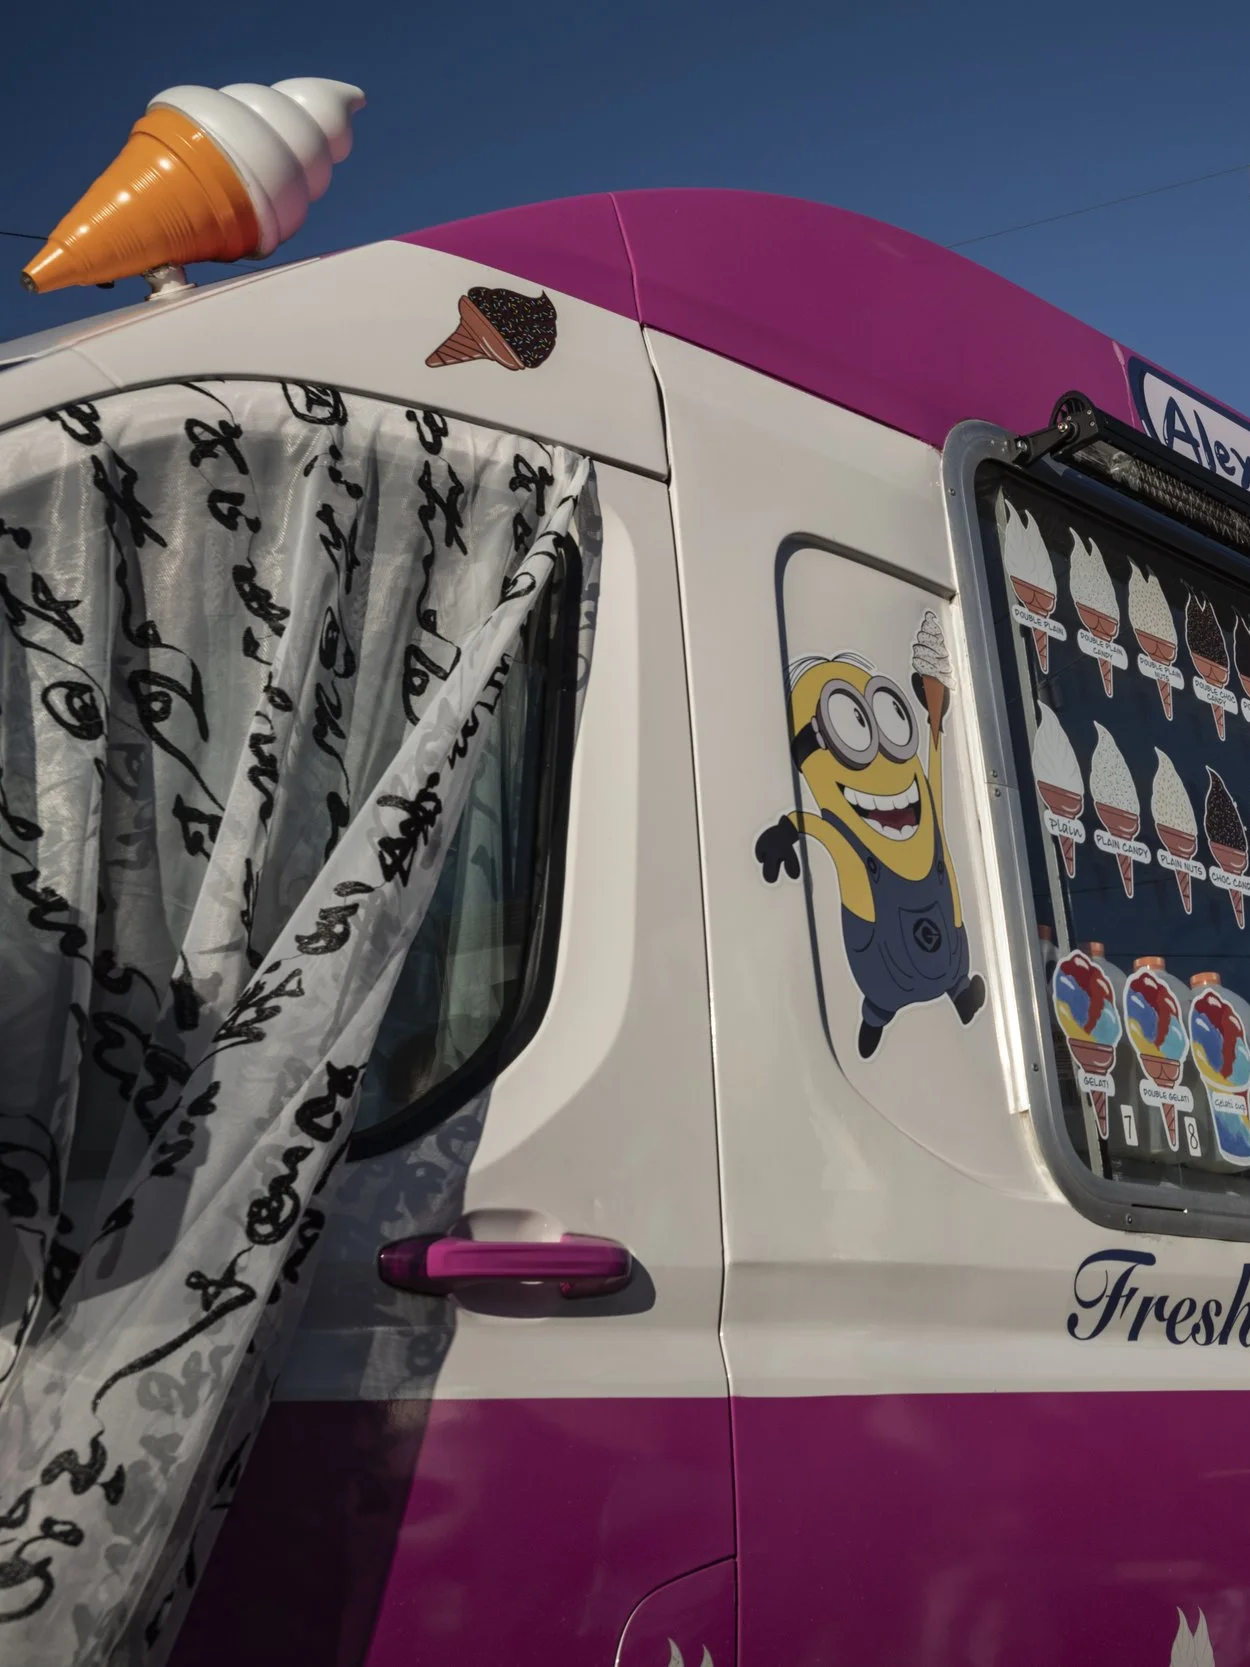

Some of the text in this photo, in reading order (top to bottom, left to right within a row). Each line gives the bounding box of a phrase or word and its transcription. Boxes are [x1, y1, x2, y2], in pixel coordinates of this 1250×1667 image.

[1014, 608, 1064, 637] DOUBLE PLAIN
[1080, 632, 1123, 657] DOUBLE PLAIN
[1092, 647, 1113, 660] CANDY
[1140, 657, 1163, 672] DOUBLE
[1195, 680, 1236, 704] DOUBLE CHOC
[1207, 694, 1226, 707] CANDY
[1096, 833, 1149, 858] PLAIN CANDY
[1160, 854, 1203, 876] PLAIN NUTS
[1211, 872, 1231, 886] CHOC
[1083, 1076, 1109, 1088] GELATI
[1143, 1088, 1189, 1103] DOUBLE GELATI
[1124, 1115, 1132, 1139] 7
[1187, 1123, 1198, 1149] 8
